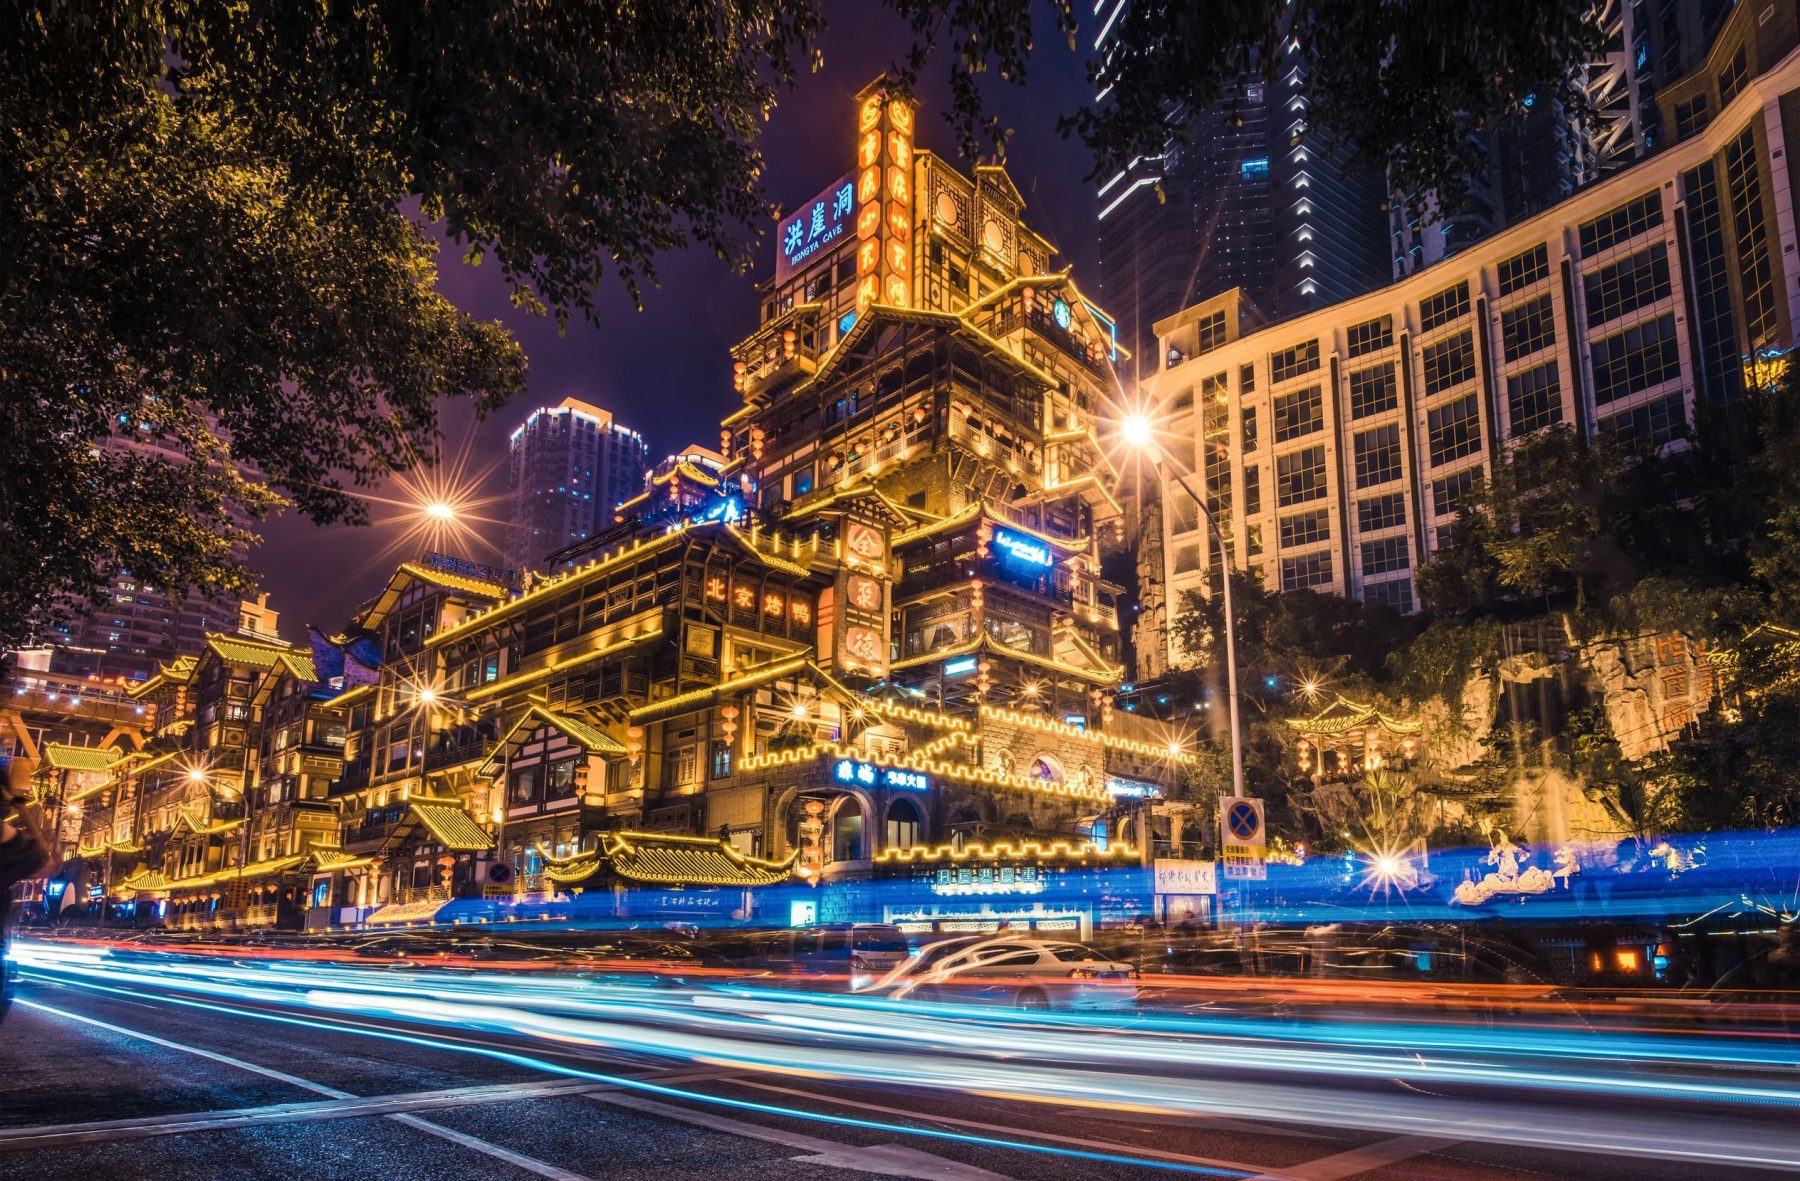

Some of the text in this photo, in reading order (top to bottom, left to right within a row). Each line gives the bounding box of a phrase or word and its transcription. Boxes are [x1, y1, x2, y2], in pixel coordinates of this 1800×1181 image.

[784, 183, 853, 256] 洪崖洞
[791, 223, 843, 265] HONGYA CAVE
[706, 578, 811, 623] 北京烤鸭
